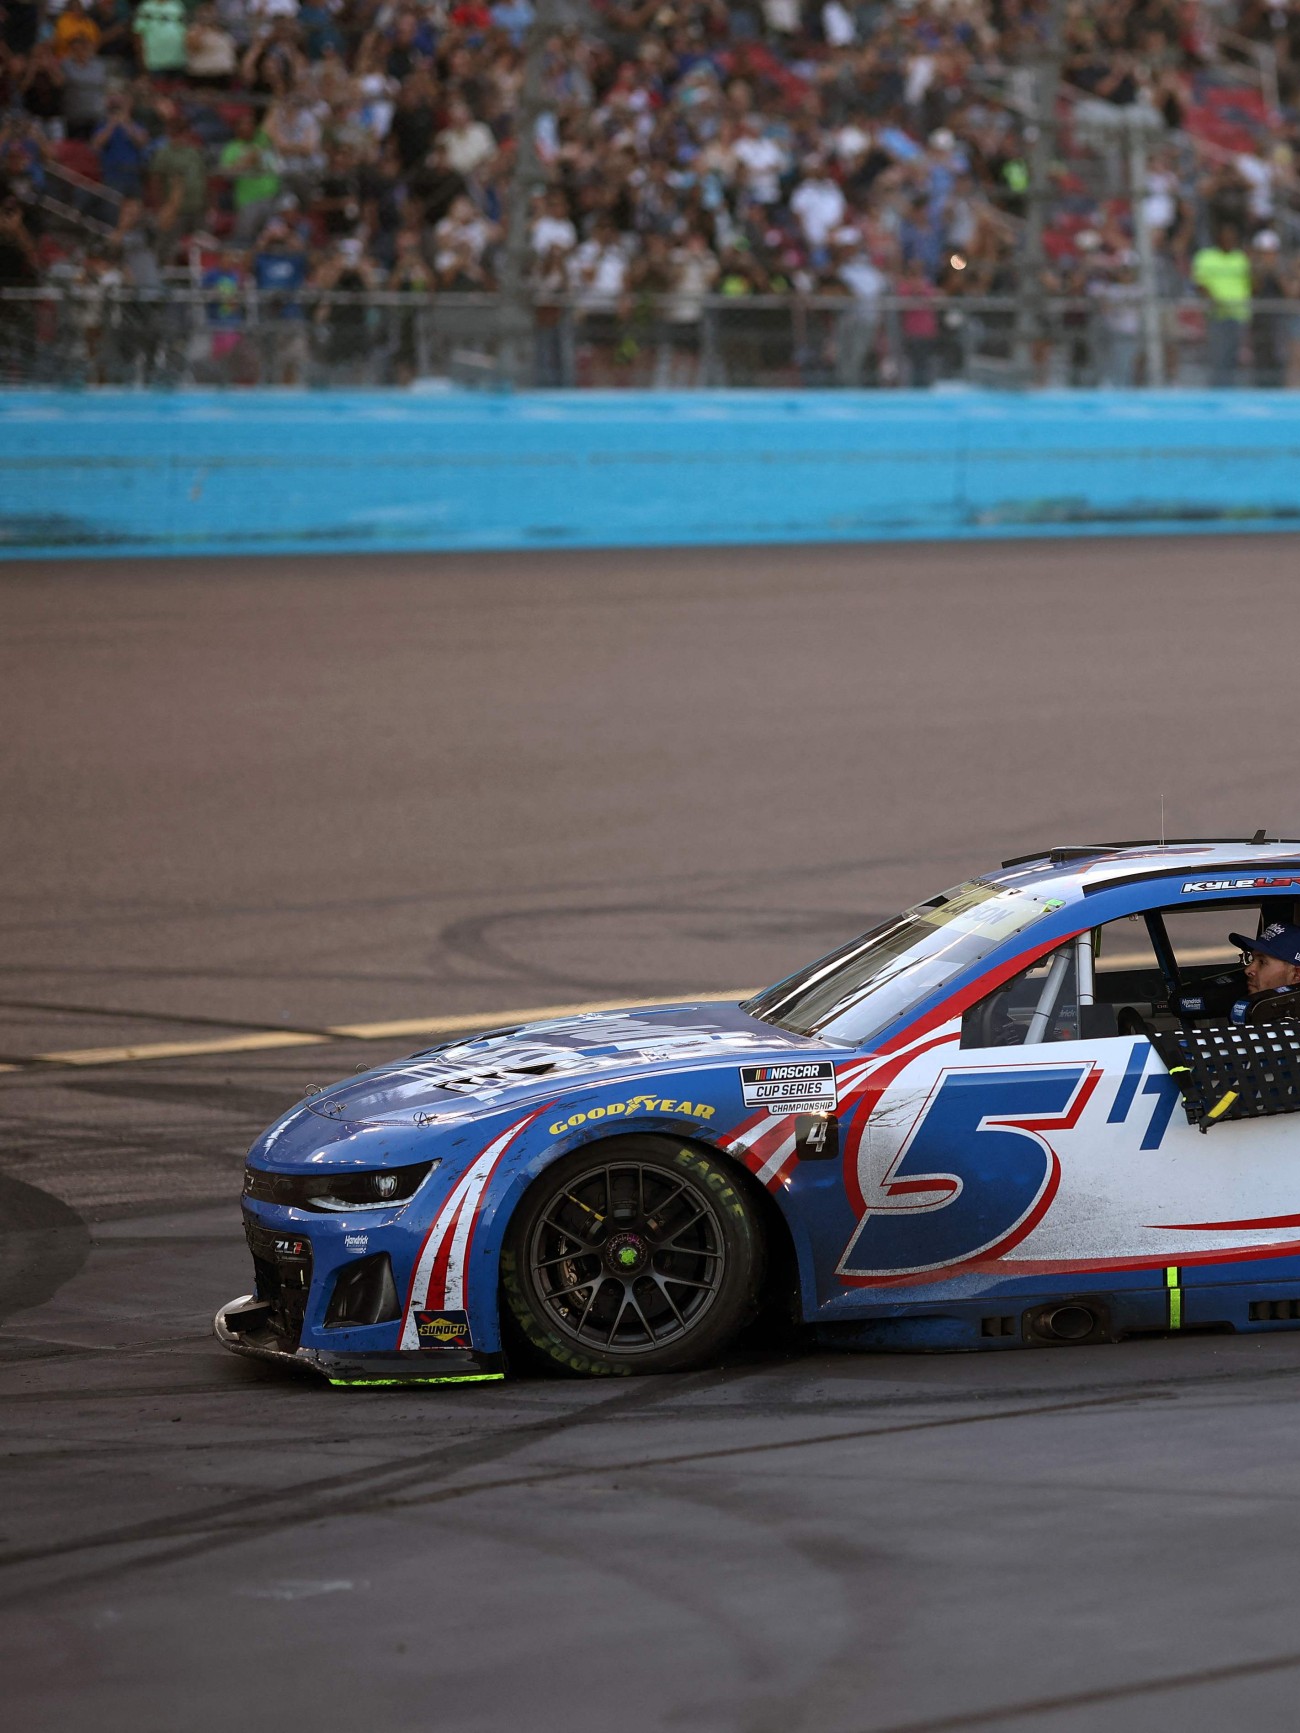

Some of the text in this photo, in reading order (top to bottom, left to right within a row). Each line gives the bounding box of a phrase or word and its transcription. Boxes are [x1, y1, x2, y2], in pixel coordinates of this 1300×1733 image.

[771, 1065, 820, 1080] NASCAR
[756, 1082, 823, 1097] CUP SERIES
[772, 1101, 834, 1113] CHAMPIONSHIP
[549, 1095, 716, 1135] GOODYEAR
[805, 1122, 829, 1153] 4
[834, 1060, 1104, 1287] 5
[420, 1324, 467, 1336] SUNOCO
